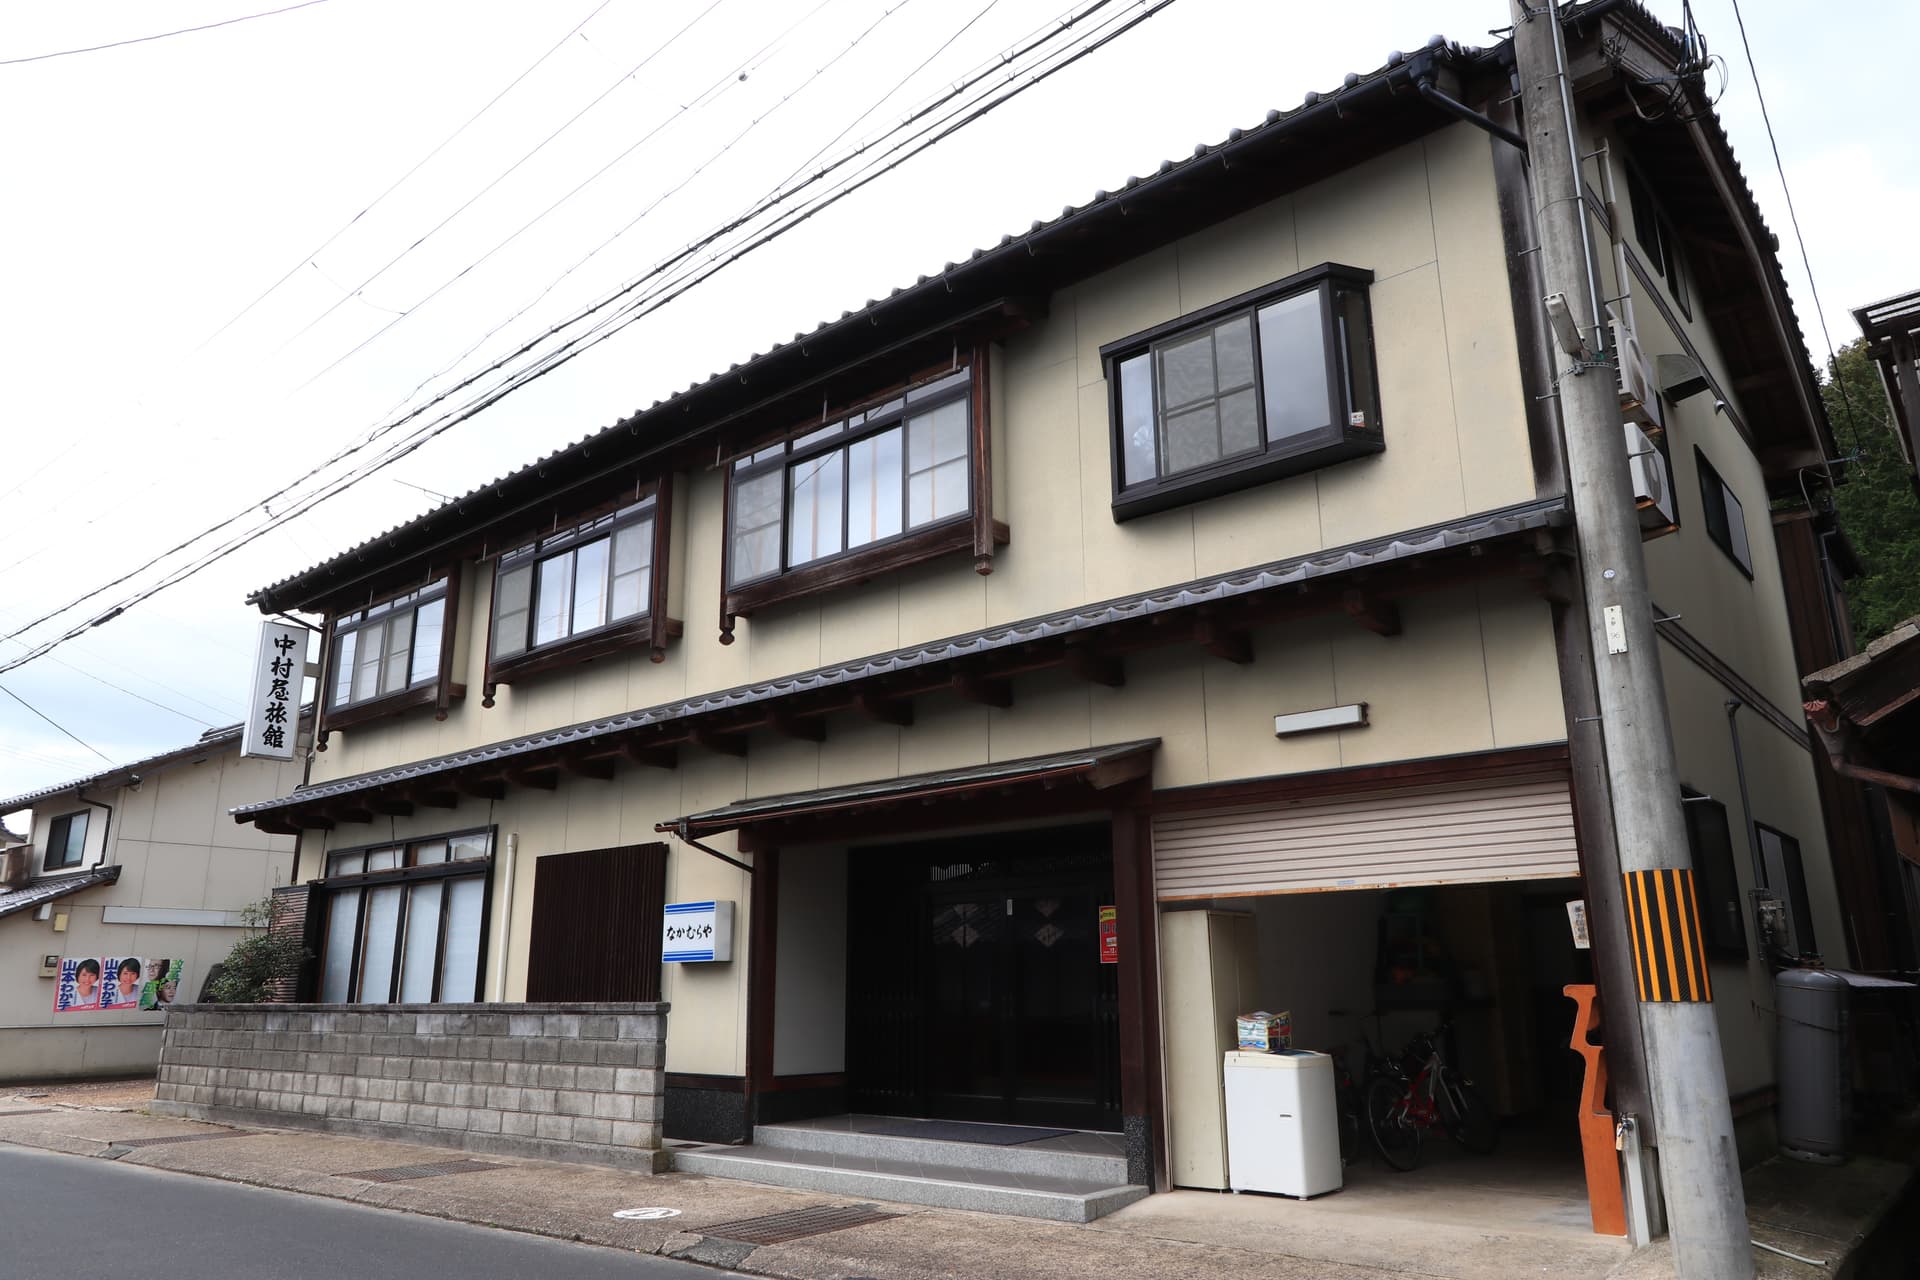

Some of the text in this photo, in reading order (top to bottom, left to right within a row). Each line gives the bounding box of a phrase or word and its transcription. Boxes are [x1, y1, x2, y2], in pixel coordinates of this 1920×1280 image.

[262, 633, 297, 749] 中村屋旅館
[666, 923, 713, 941] なかむらや
[57, 959, 78, 1011] 山本わか子
[100, 958, 119, 1009] 山本わか子
